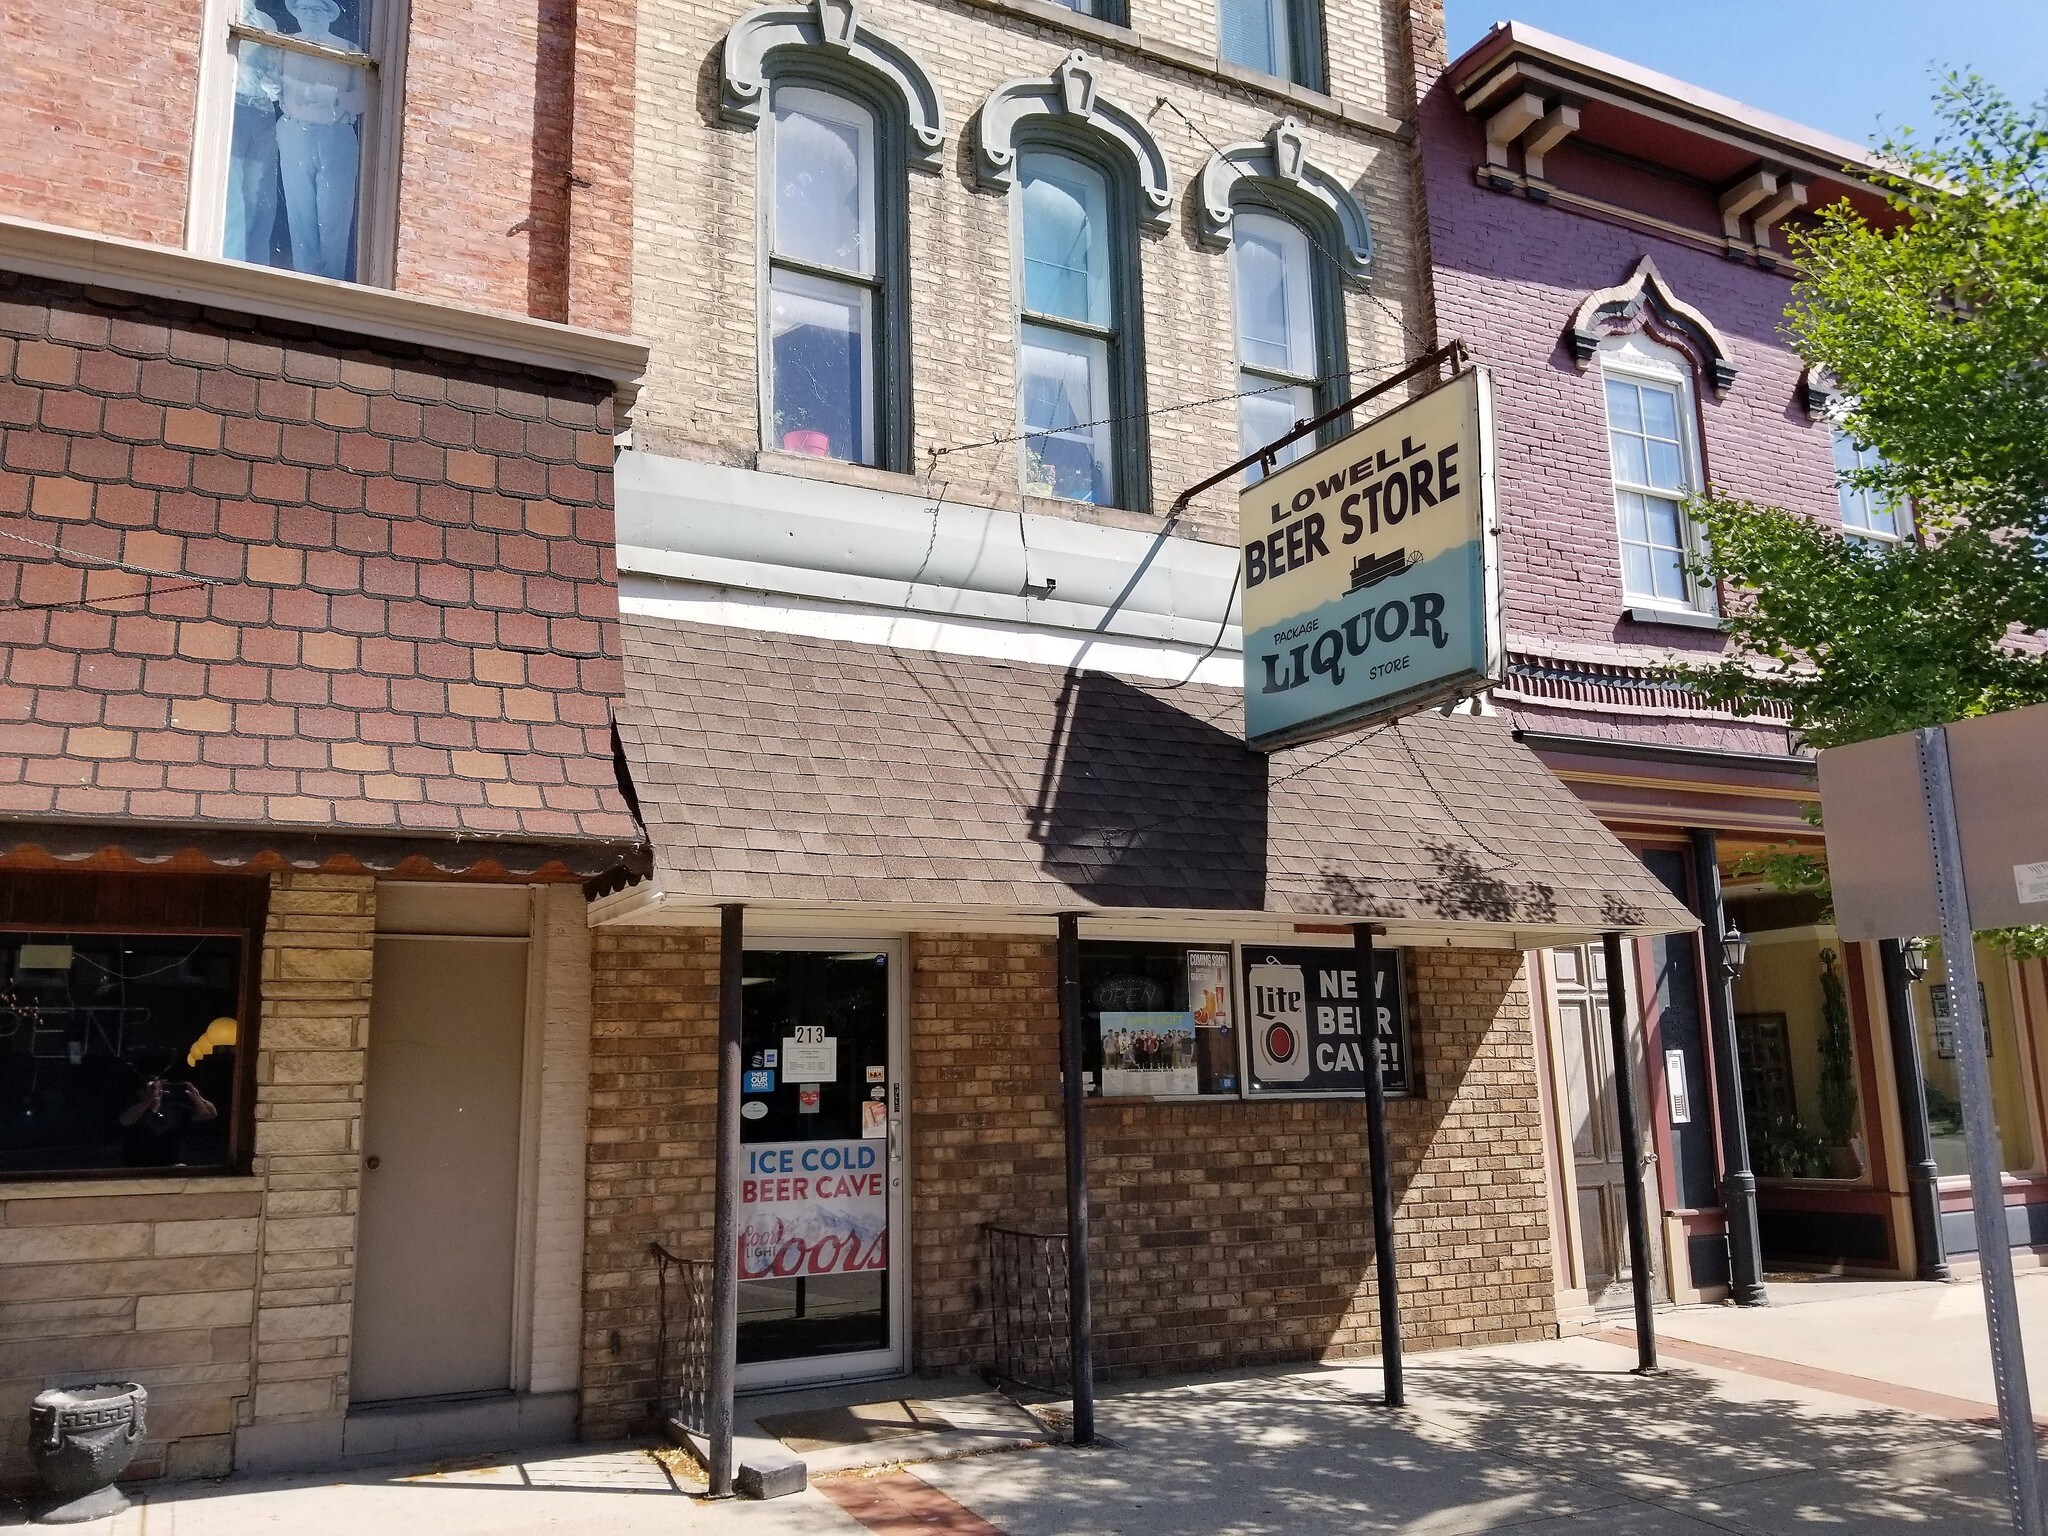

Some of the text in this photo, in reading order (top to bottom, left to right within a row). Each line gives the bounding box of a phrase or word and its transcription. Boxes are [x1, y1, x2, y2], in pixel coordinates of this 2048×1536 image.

[1271, 436, 1427, 524] LOWELL
[1244, 442, 1461, 590] BEER STORE
[1261, 592, 1449, 695] LIQUOR
[1273, 618, 1320, 645] PACKAGE
[1368, 655, 1410, 681] STORE
[1190, 953, 1227, 967] COMING SOON
[1100, 987, 1157, 1004] OPEN
[1254, 985, 1301, 1020] Lite
[796, 1026, 824, 1044] 213
[751, 1076, 768, 1084] OUR
[750, 1146, 876, 1174] ICE COLD
[742, 1173, 882, 1204] BEER CAVE
[746, 1246, 776, 1258] LIGHT
